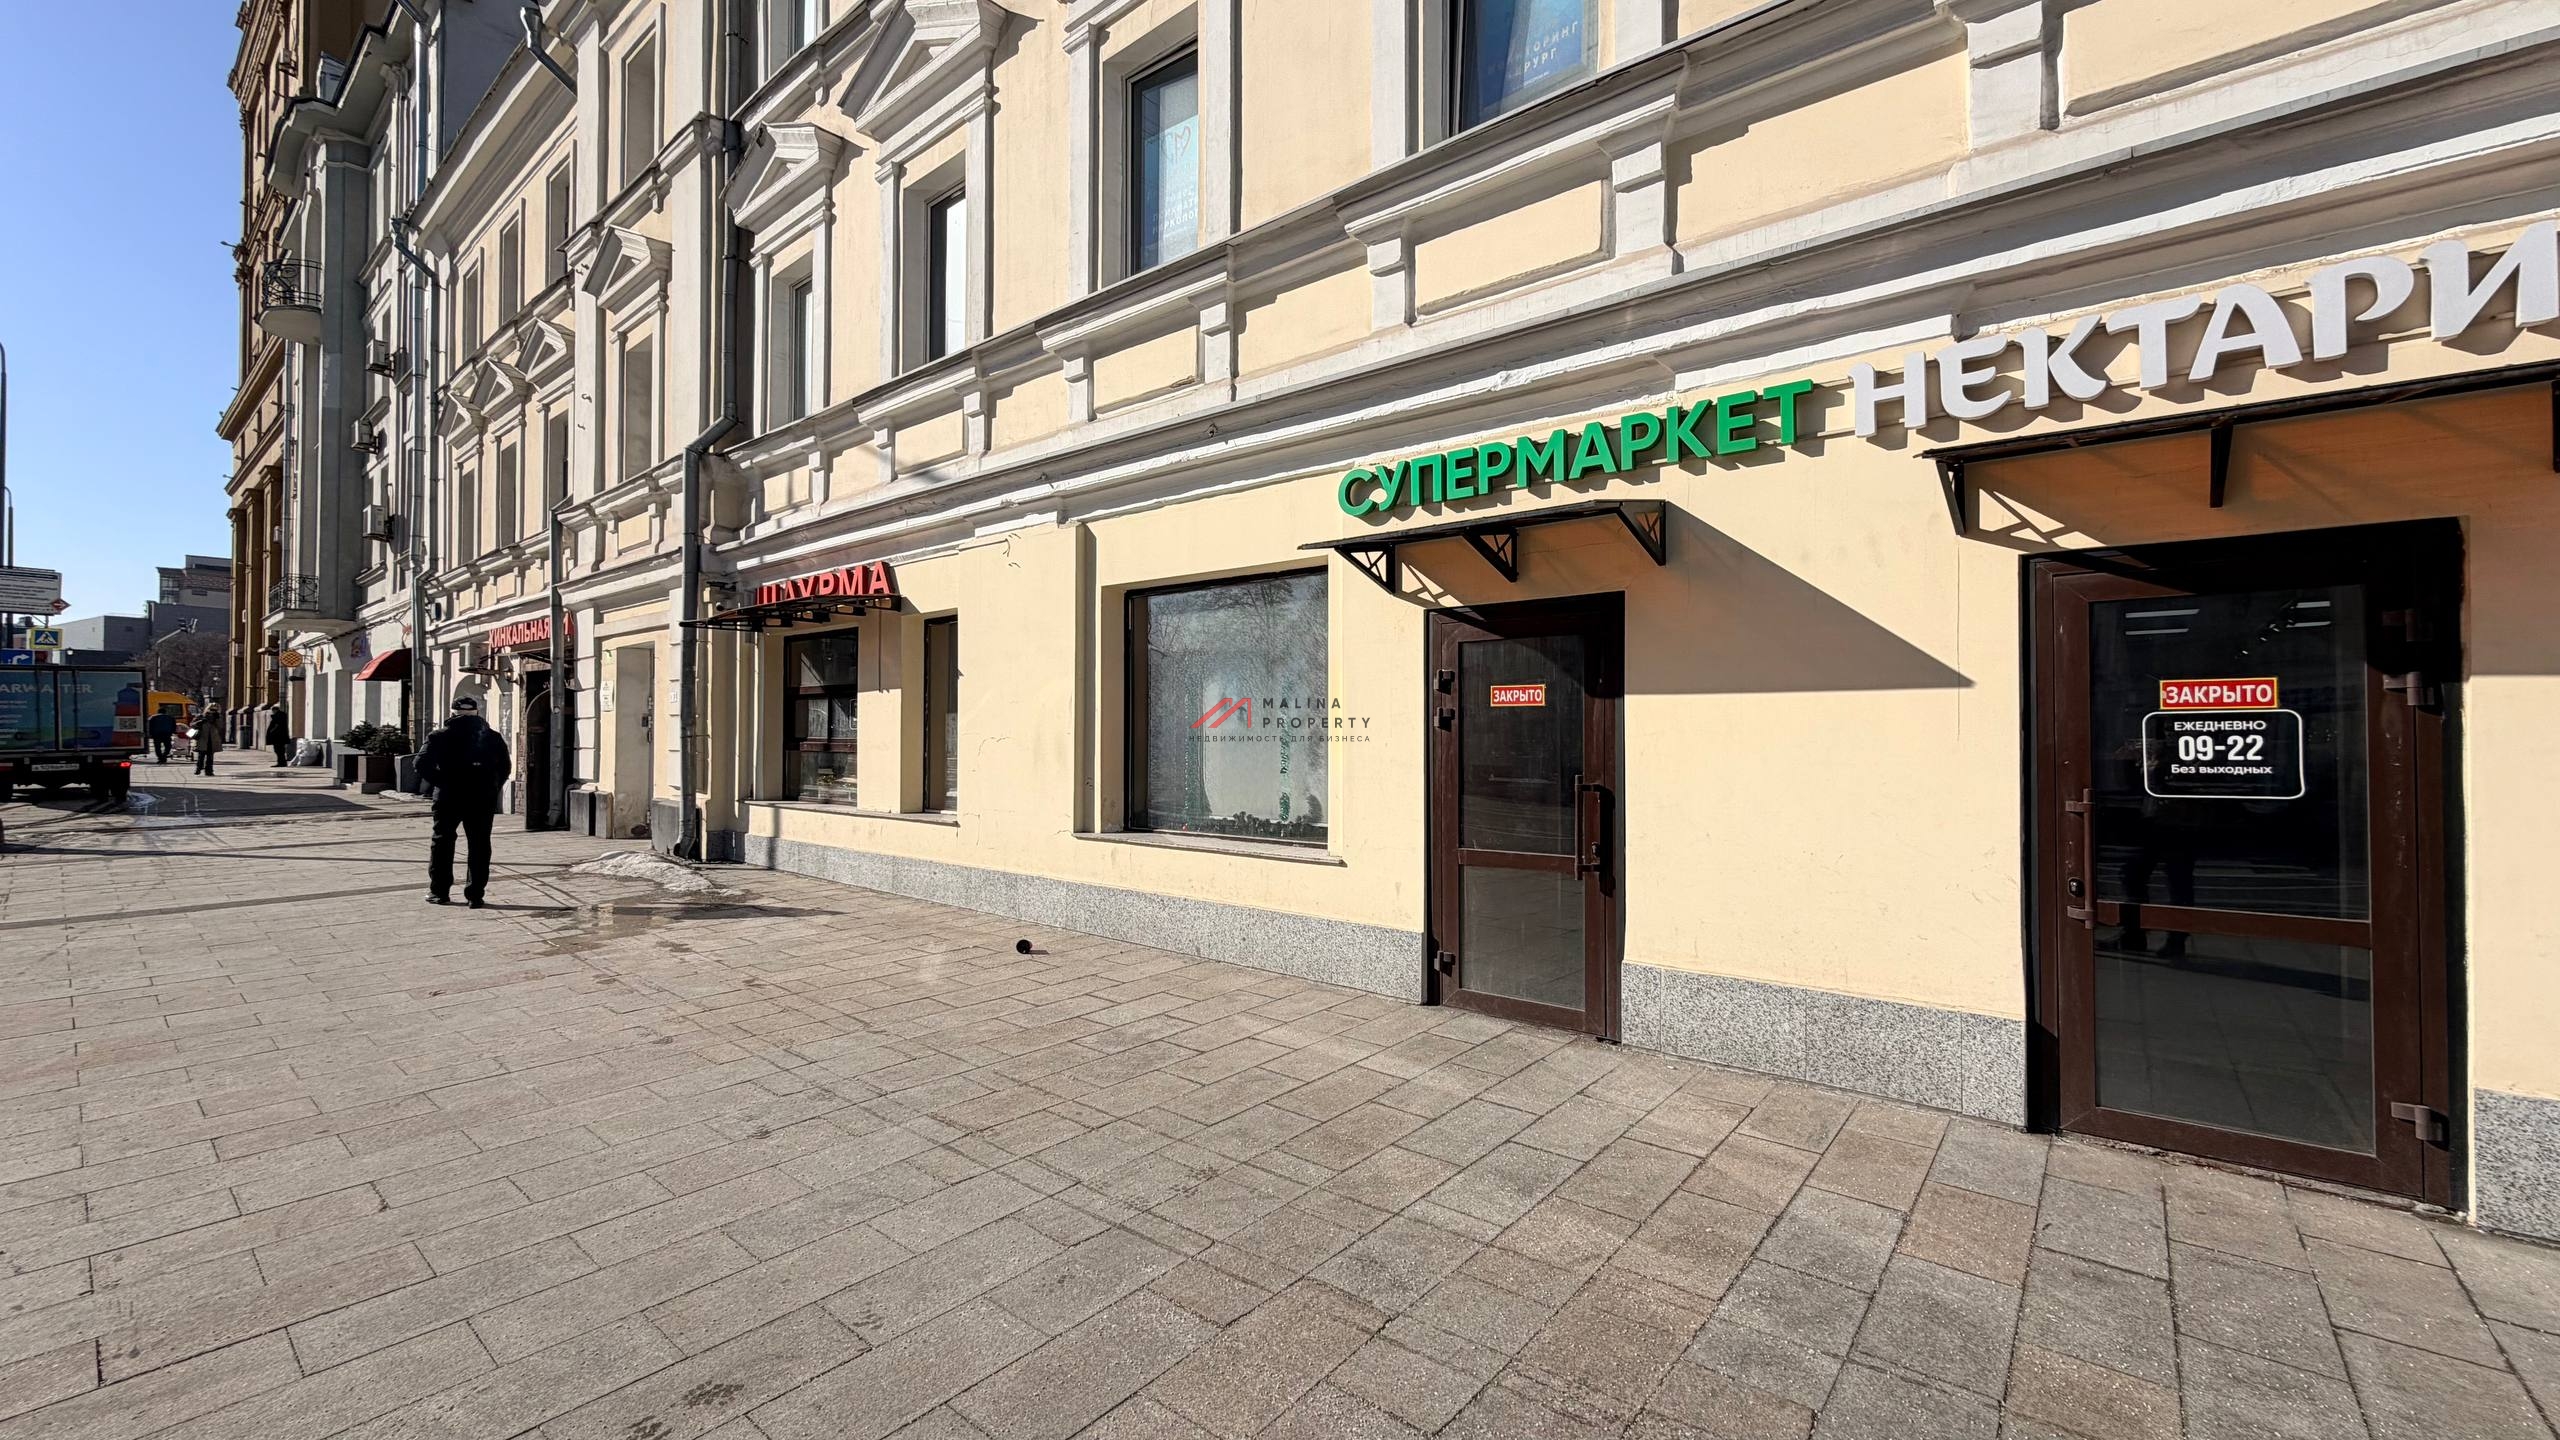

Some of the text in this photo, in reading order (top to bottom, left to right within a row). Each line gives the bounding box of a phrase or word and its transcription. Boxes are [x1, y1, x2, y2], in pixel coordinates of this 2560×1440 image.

[1337, 221, 2559, 517] СУПЕРМАРКЕТ НЕКТАРИ
[757, 560, 890, 605] ШАУРМА
[489, 617, 550, 648] ХИНКАЛЬНАЯ
[1493, 689, 1542, 702] ЗАКРЫТО
[2165, 684, 2272, 704] ЗАКРЫТО
[2174, 720, 2267, 732] ЕЖЕДНЕВНО
[2178, 735, 2264, 761] 09-22
[2171, 764, 2272, 775] Без выходных
